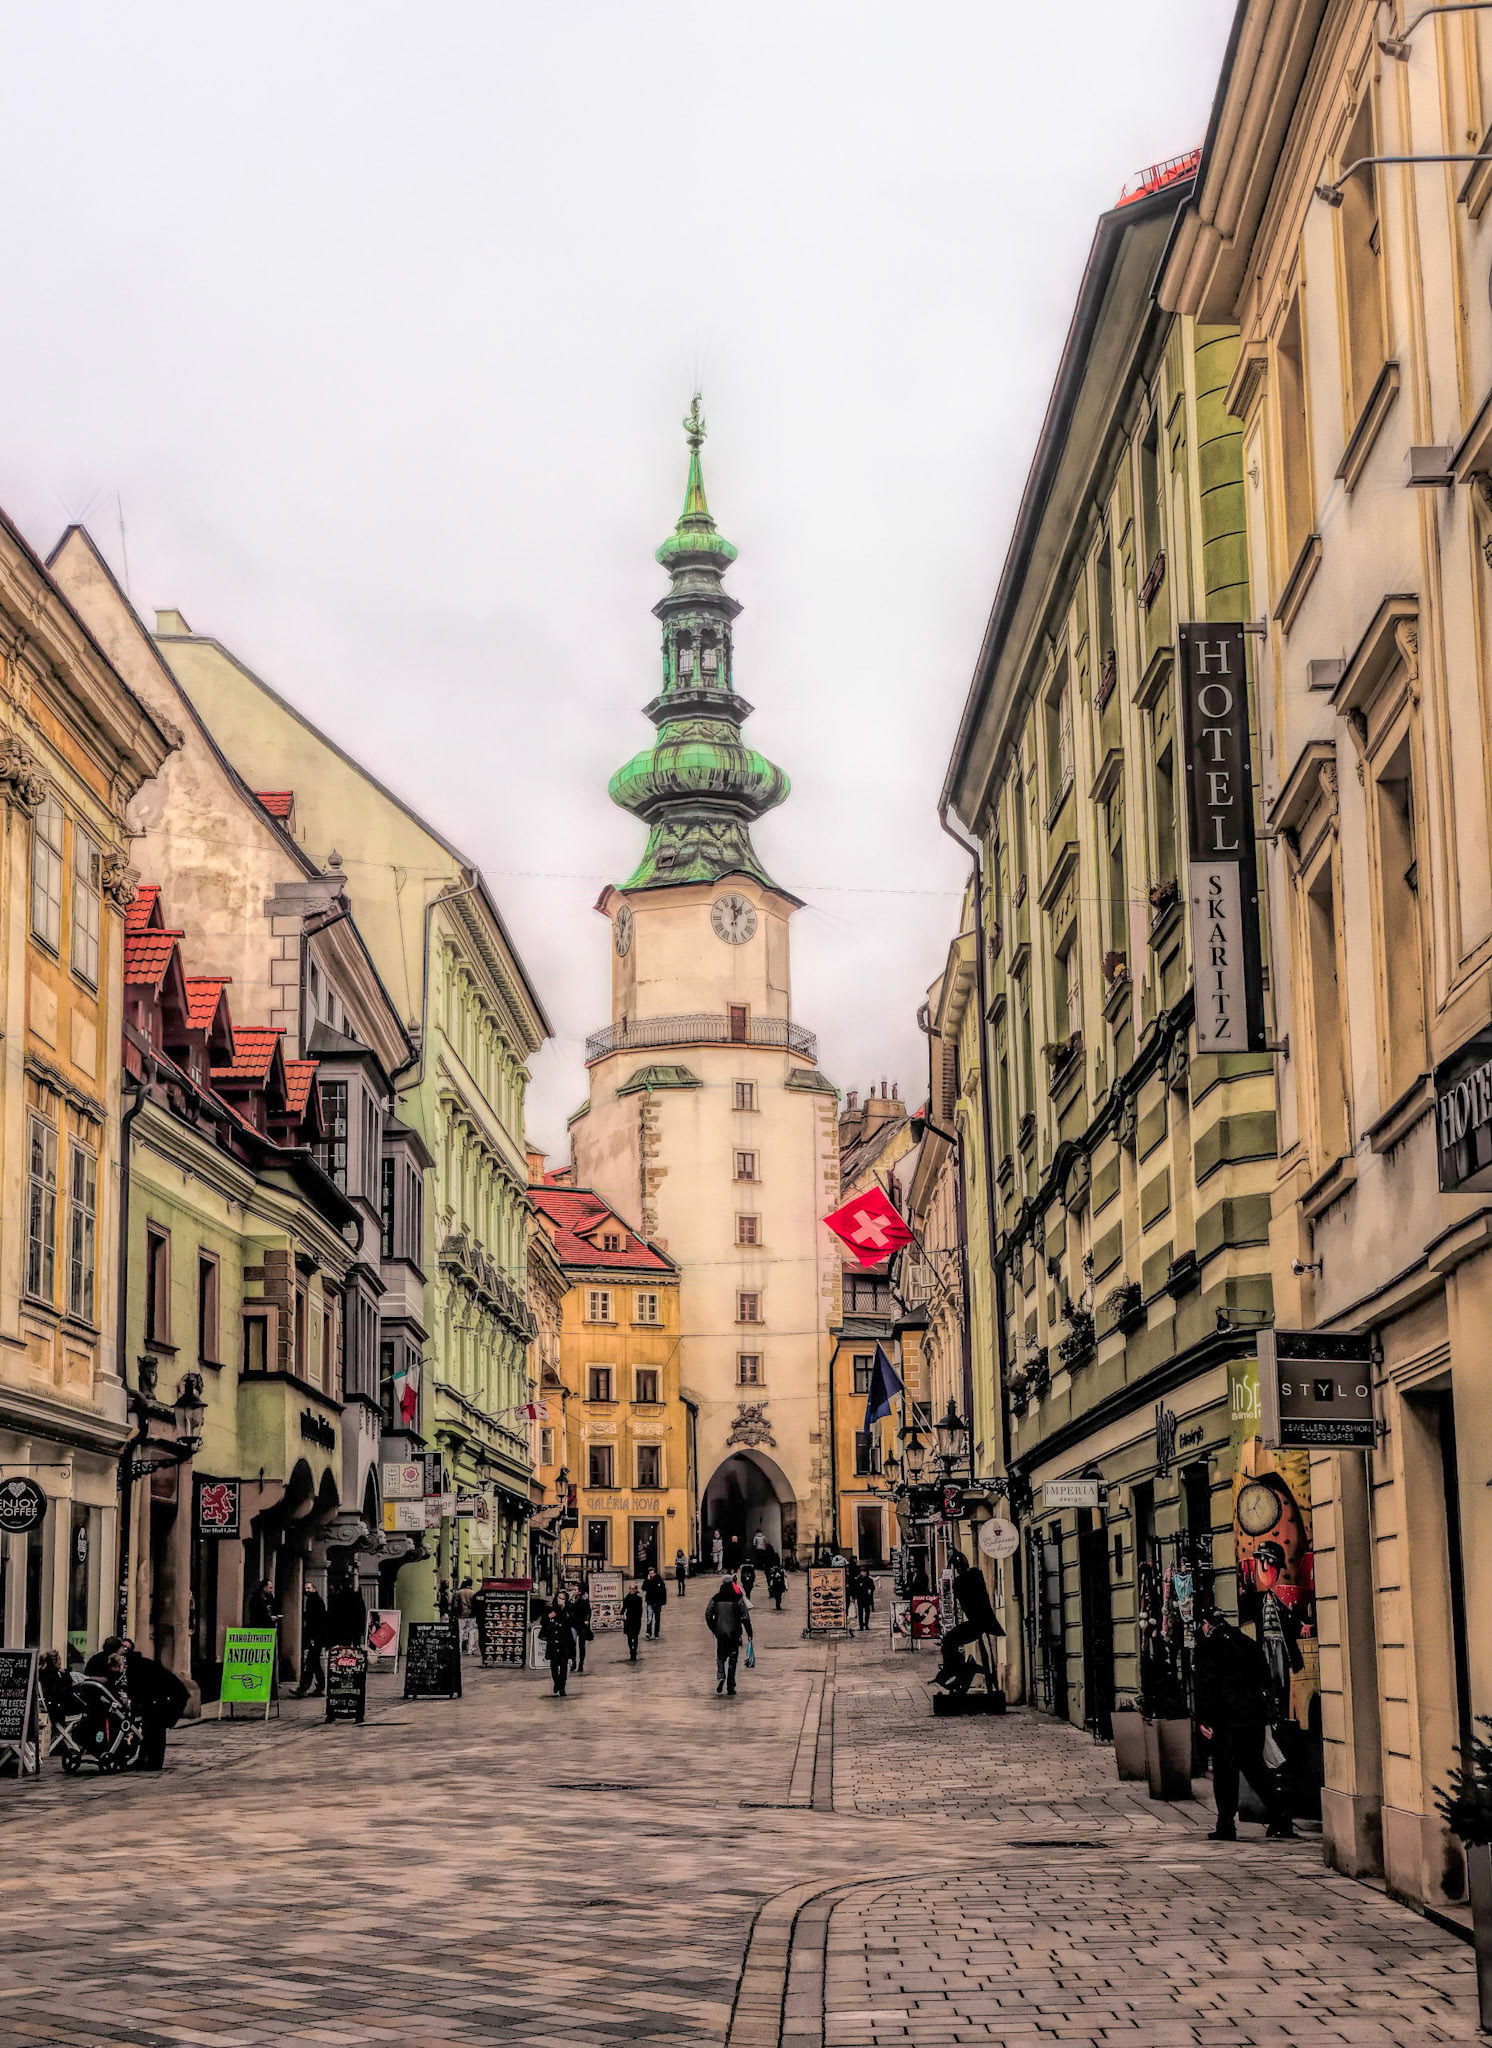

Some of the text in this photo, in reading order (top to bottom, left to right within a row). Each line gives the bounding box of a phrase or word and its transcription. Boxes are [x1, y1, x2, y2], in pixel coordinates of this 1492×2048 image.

[1195, 640, 1239, 851] HOTEL
[1206, 874, 1233, 1040] SKARITZ
[1439, 1060, 1492, 1150] HOTE
[1281, 1382, 1369, 1398] STYLO
[1302, 1432, 1355, 1441] ACCESSORIES
[1046, 1486, 1095, 1496] IMPERIA
[632, 1497, 660, 1510] NOVA
[227, 1648, 271, 1666] ANTIQUES
